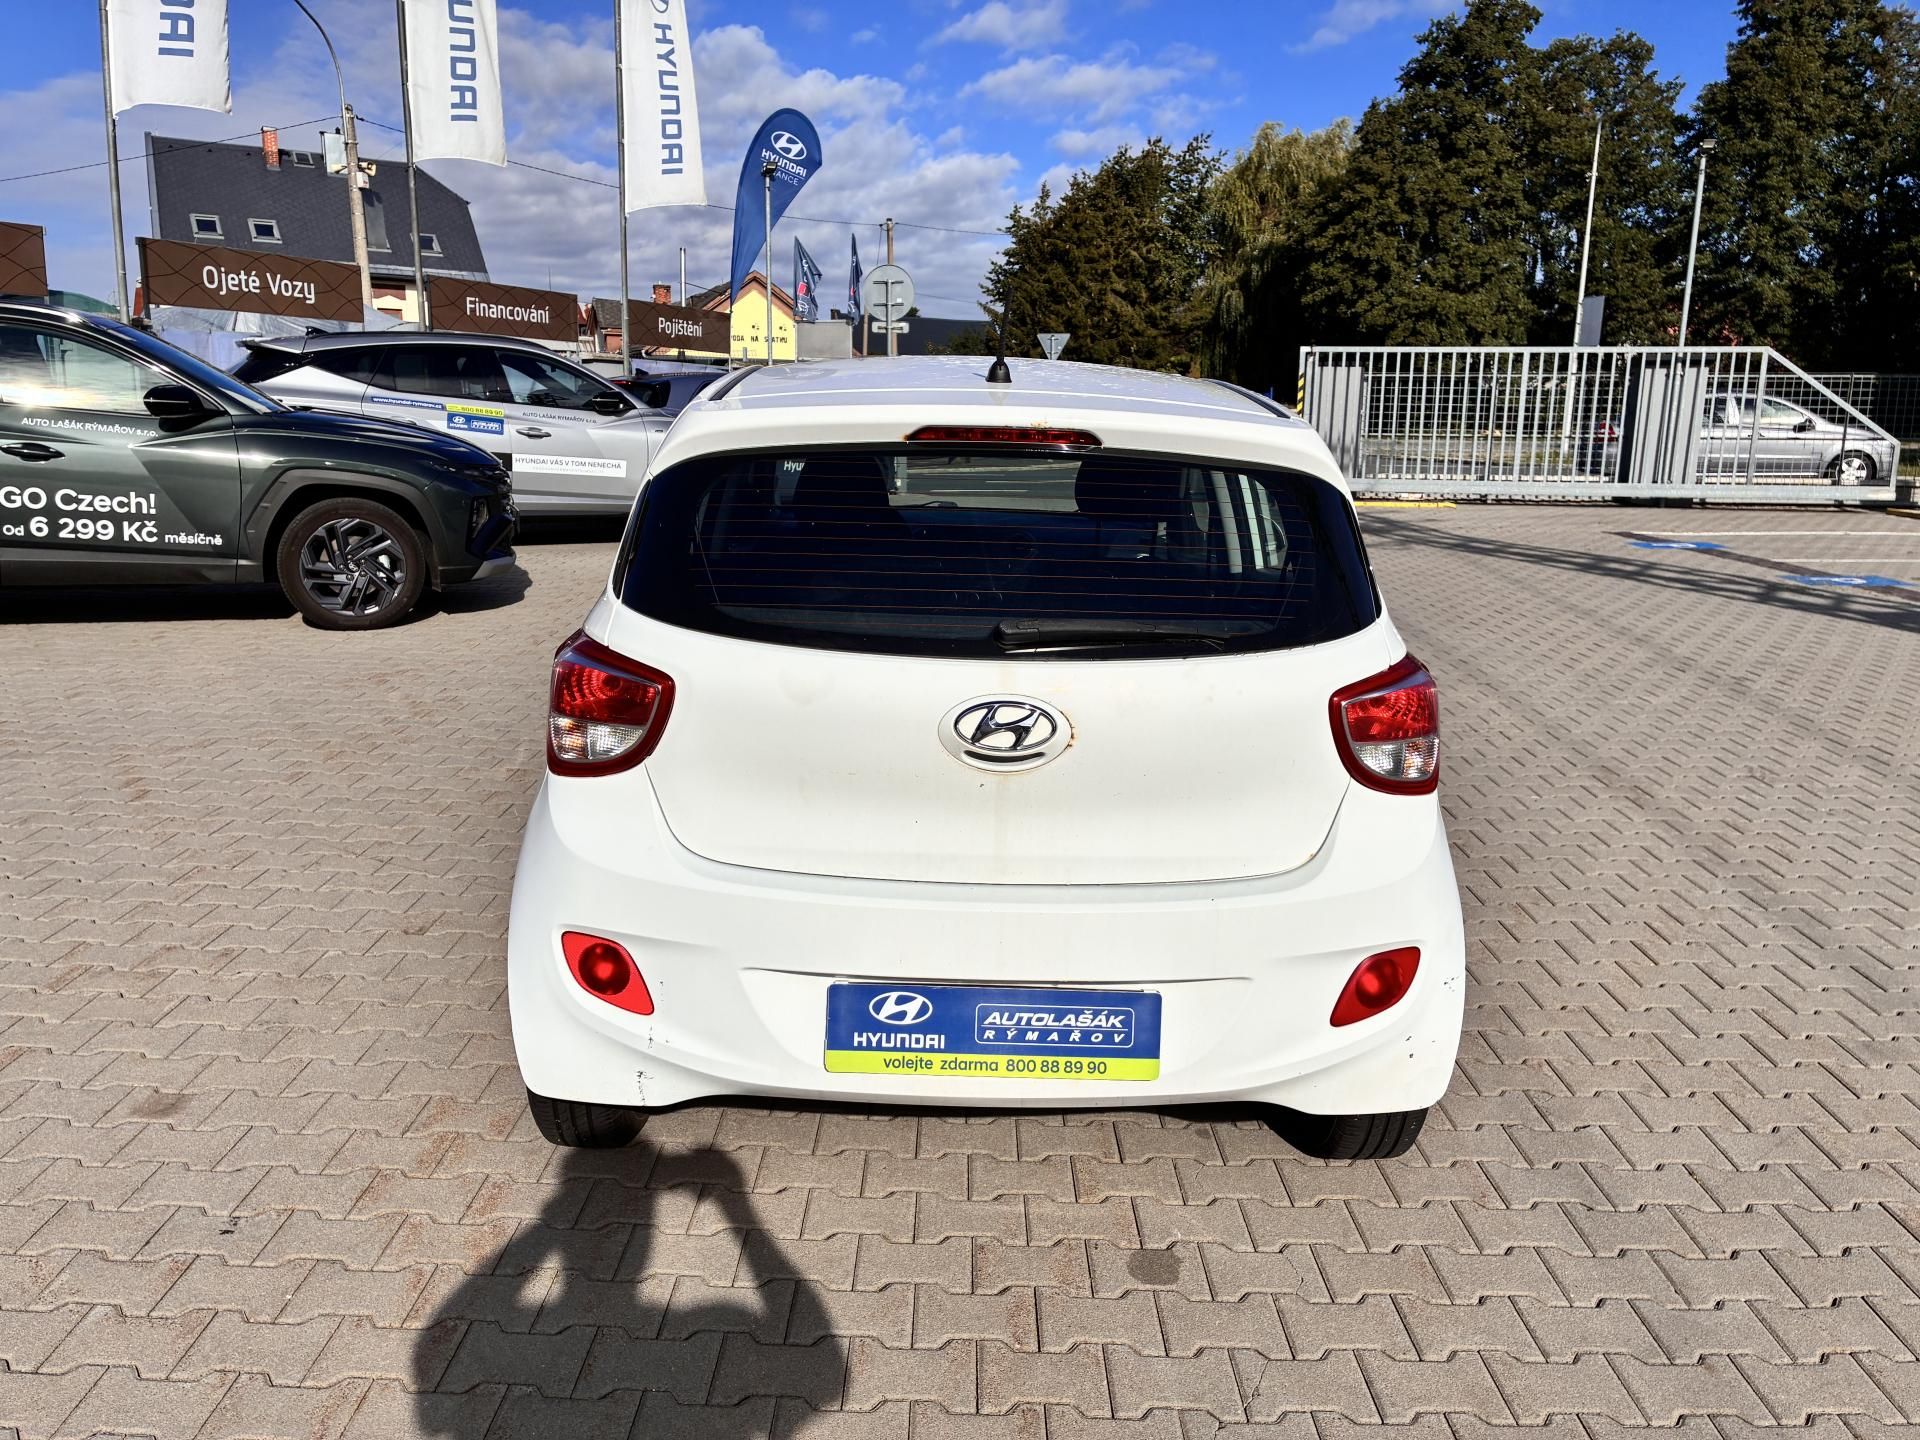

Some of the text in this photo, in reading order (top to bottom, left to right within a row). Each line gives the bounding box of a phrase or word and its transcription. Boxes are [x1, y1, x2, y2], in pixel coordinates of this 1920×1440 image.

[653, 23, 683, 175] HYUNDAI
[761, 148, 807, 177] HYUNDAI
[202, 265, 315, 304] Ojeté Vozy
[466, 297, 549, 324] Financování
[658, 316, 703, 338] Pojištění
[21, 417, 159, 437] AUTO LAŠÁK RÝMAŘOV s.r.o.
[515, 457, 548, 465] HYUNDAI
[0, 486, 157, 515] GO Czech!
[29, 516, 49, 538] 6
[58, 517, 115, 541] 299
[123, 520, 158, 543] Kč
[164, 532, 223, 546] měsíčně
[983, 1010, 1126, 1028] AUTOLAŠÁK
[853, 1031, 945, 1049] HYUNDAI
[983, 1028, 1125, 1043] RÝMAŘOV
[883, 1055, 1107, 1074] volejte zdarma 800 88 89 90
